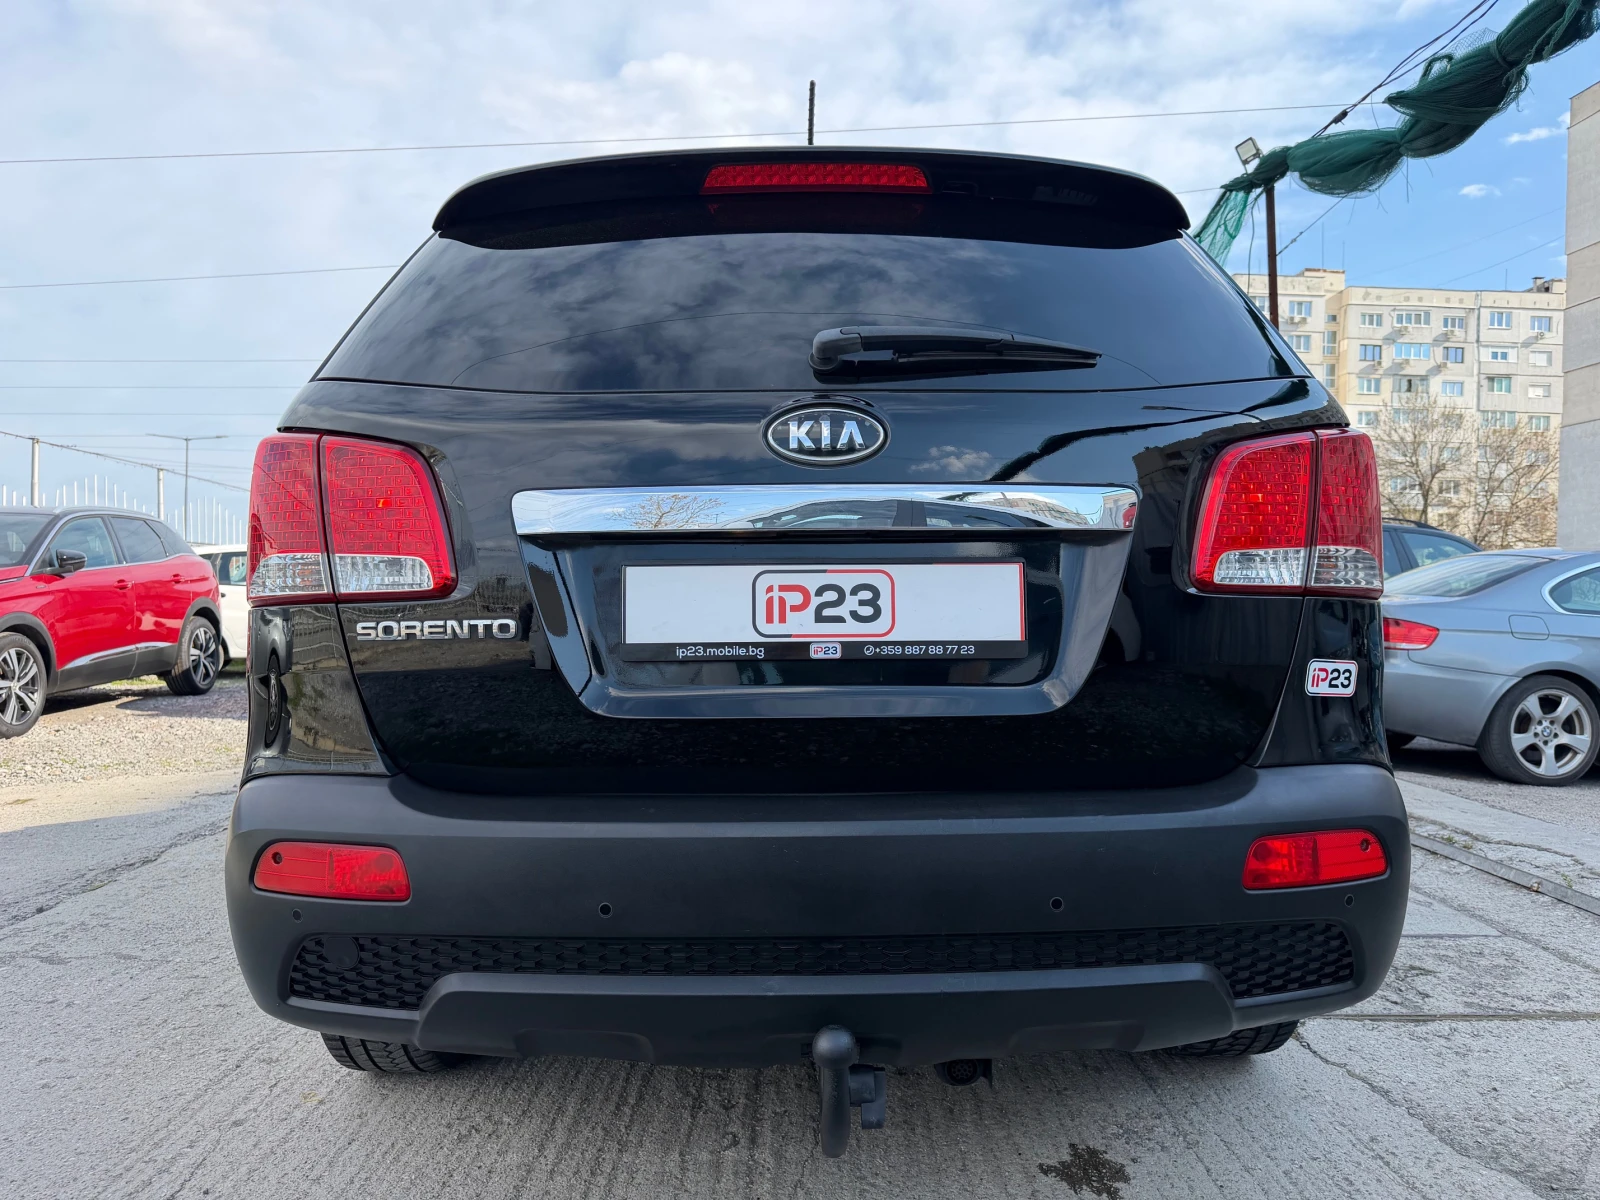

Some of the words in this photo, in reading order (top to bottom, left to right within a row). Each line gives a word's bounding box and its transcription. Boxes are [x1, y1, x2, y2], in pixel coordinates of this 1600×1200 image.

[788, 420, 866, 450] KIA
[356, 619, 517, 641] SORENTO
[676, 645, 765, 659] ip23.mobile.bg
[875, 645, 902, 655] +359
[905, 645, 926, 655] 887
[928, 645, 943, 655] 88
[946, 645, 958, 655] 77
[960, 645, 975, 655] 23
